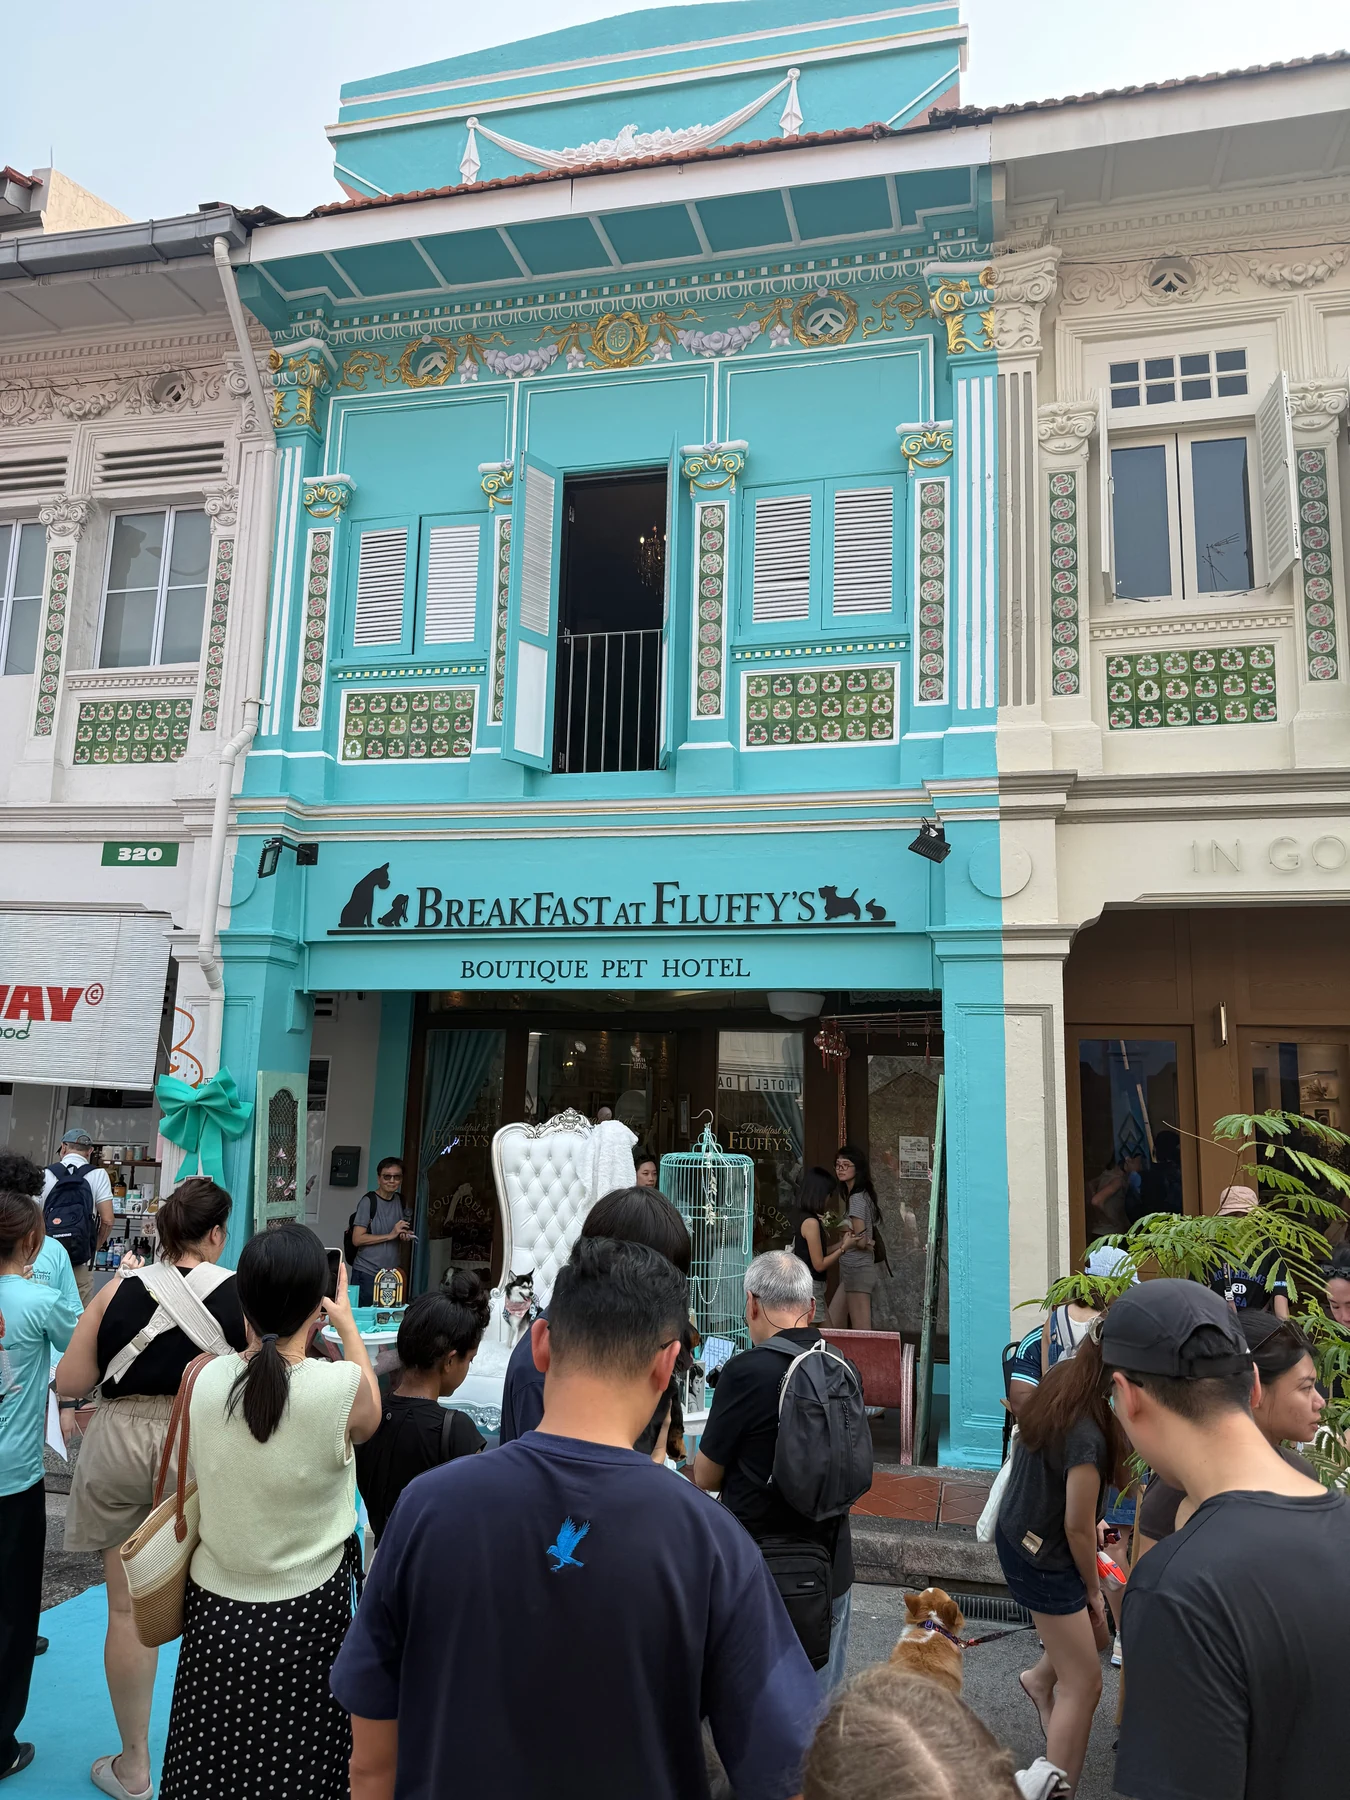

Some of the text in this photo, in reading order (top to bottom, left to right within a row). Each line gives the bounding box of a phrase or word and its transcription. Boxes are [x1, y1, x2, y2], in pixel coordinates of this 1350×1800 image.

[117, 847, 163, 861] 320
[1192, 838, 1240, 873] IN
[613, 902, 646, 925] AT
[652, 881, 816, 925] FLUFFY'S
[460, 958, 751, 983] BOUTIQUE PET HOTEL
[0, 1016, 31, 1040] od
[740, 1122, 781, 1138] Breakfast
[1234, 1285, 1244, 1293] 31
